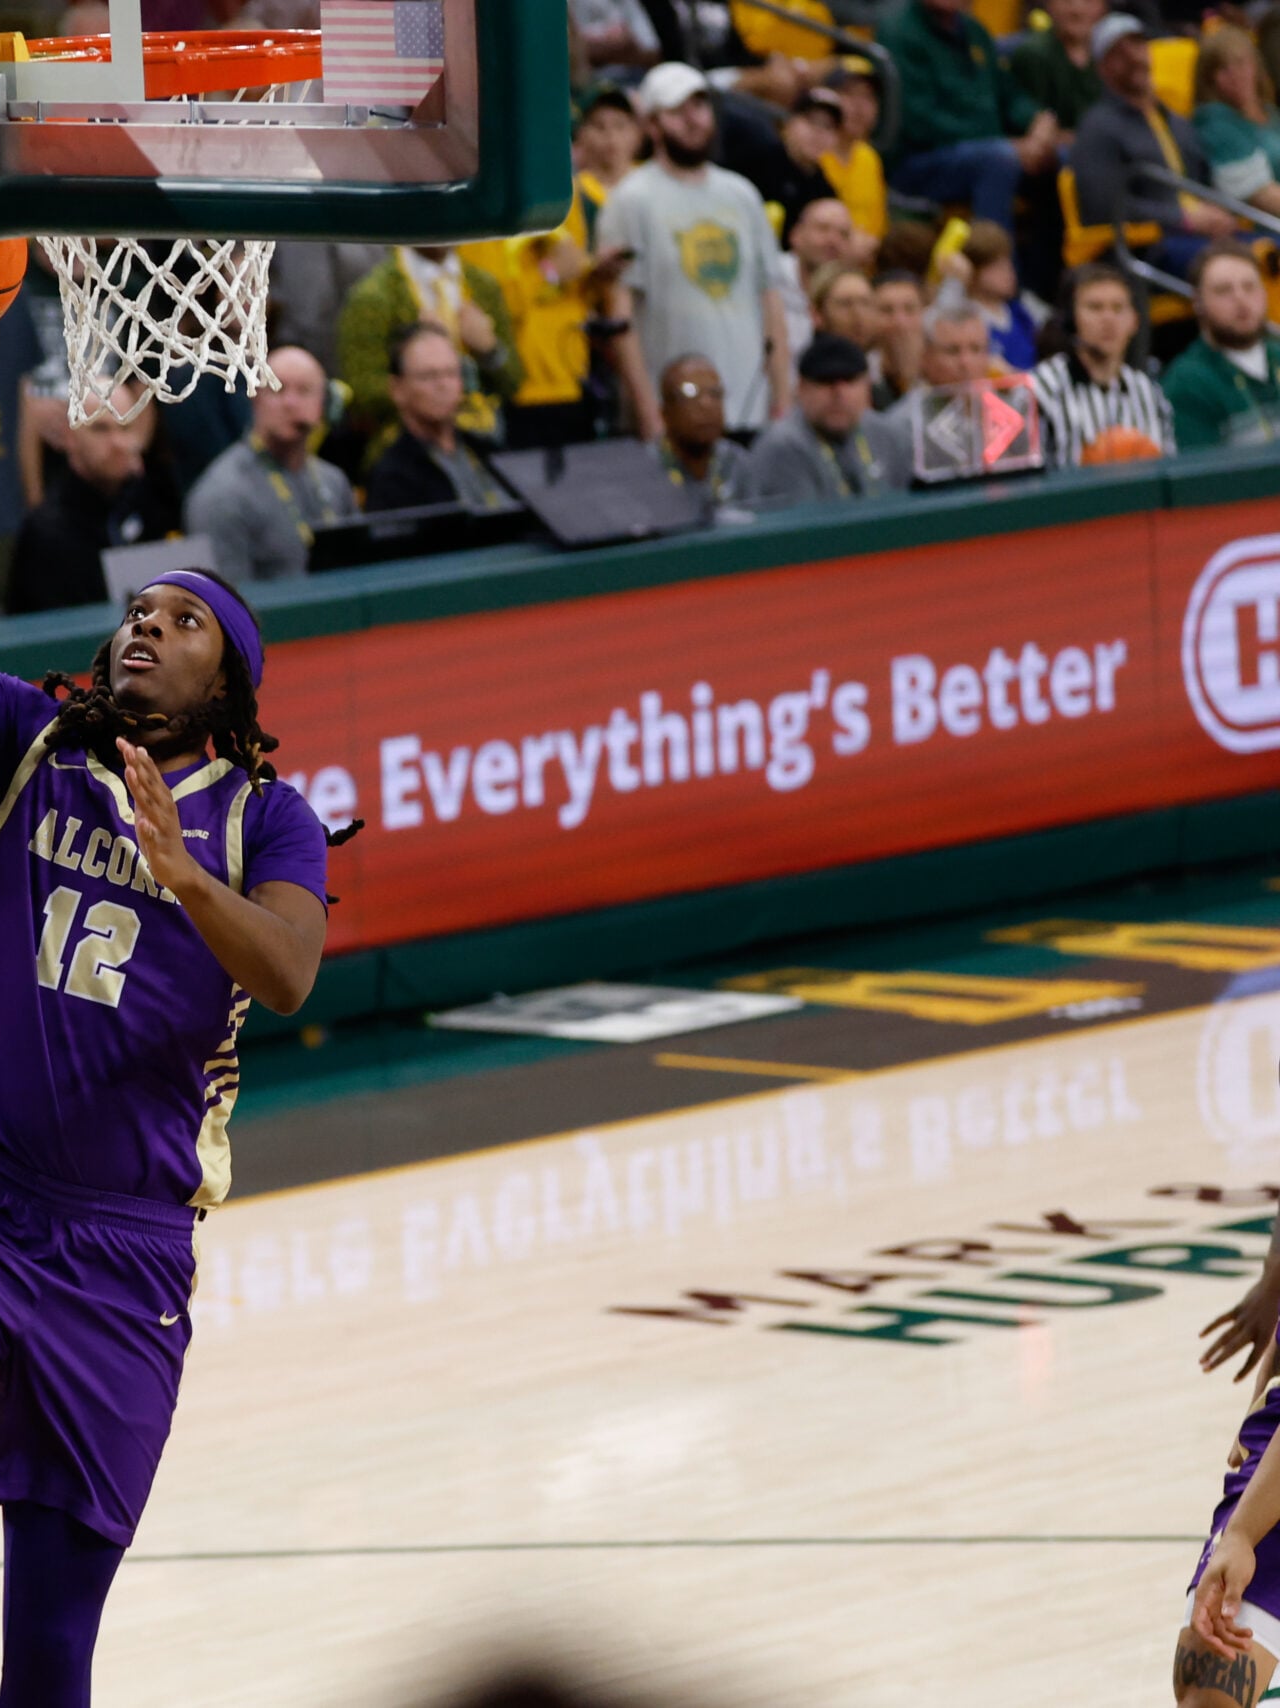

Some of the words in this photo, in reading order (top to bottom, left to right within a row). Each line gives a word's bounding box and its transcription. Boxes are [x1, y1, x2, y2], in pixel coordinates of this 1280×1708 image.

[380, 668, 871, 831] Everything's
[891, 637, 1128, 744] Better
[28, 808, 182, 905] ALCOR
[36, 885, 142, 1008] 12
